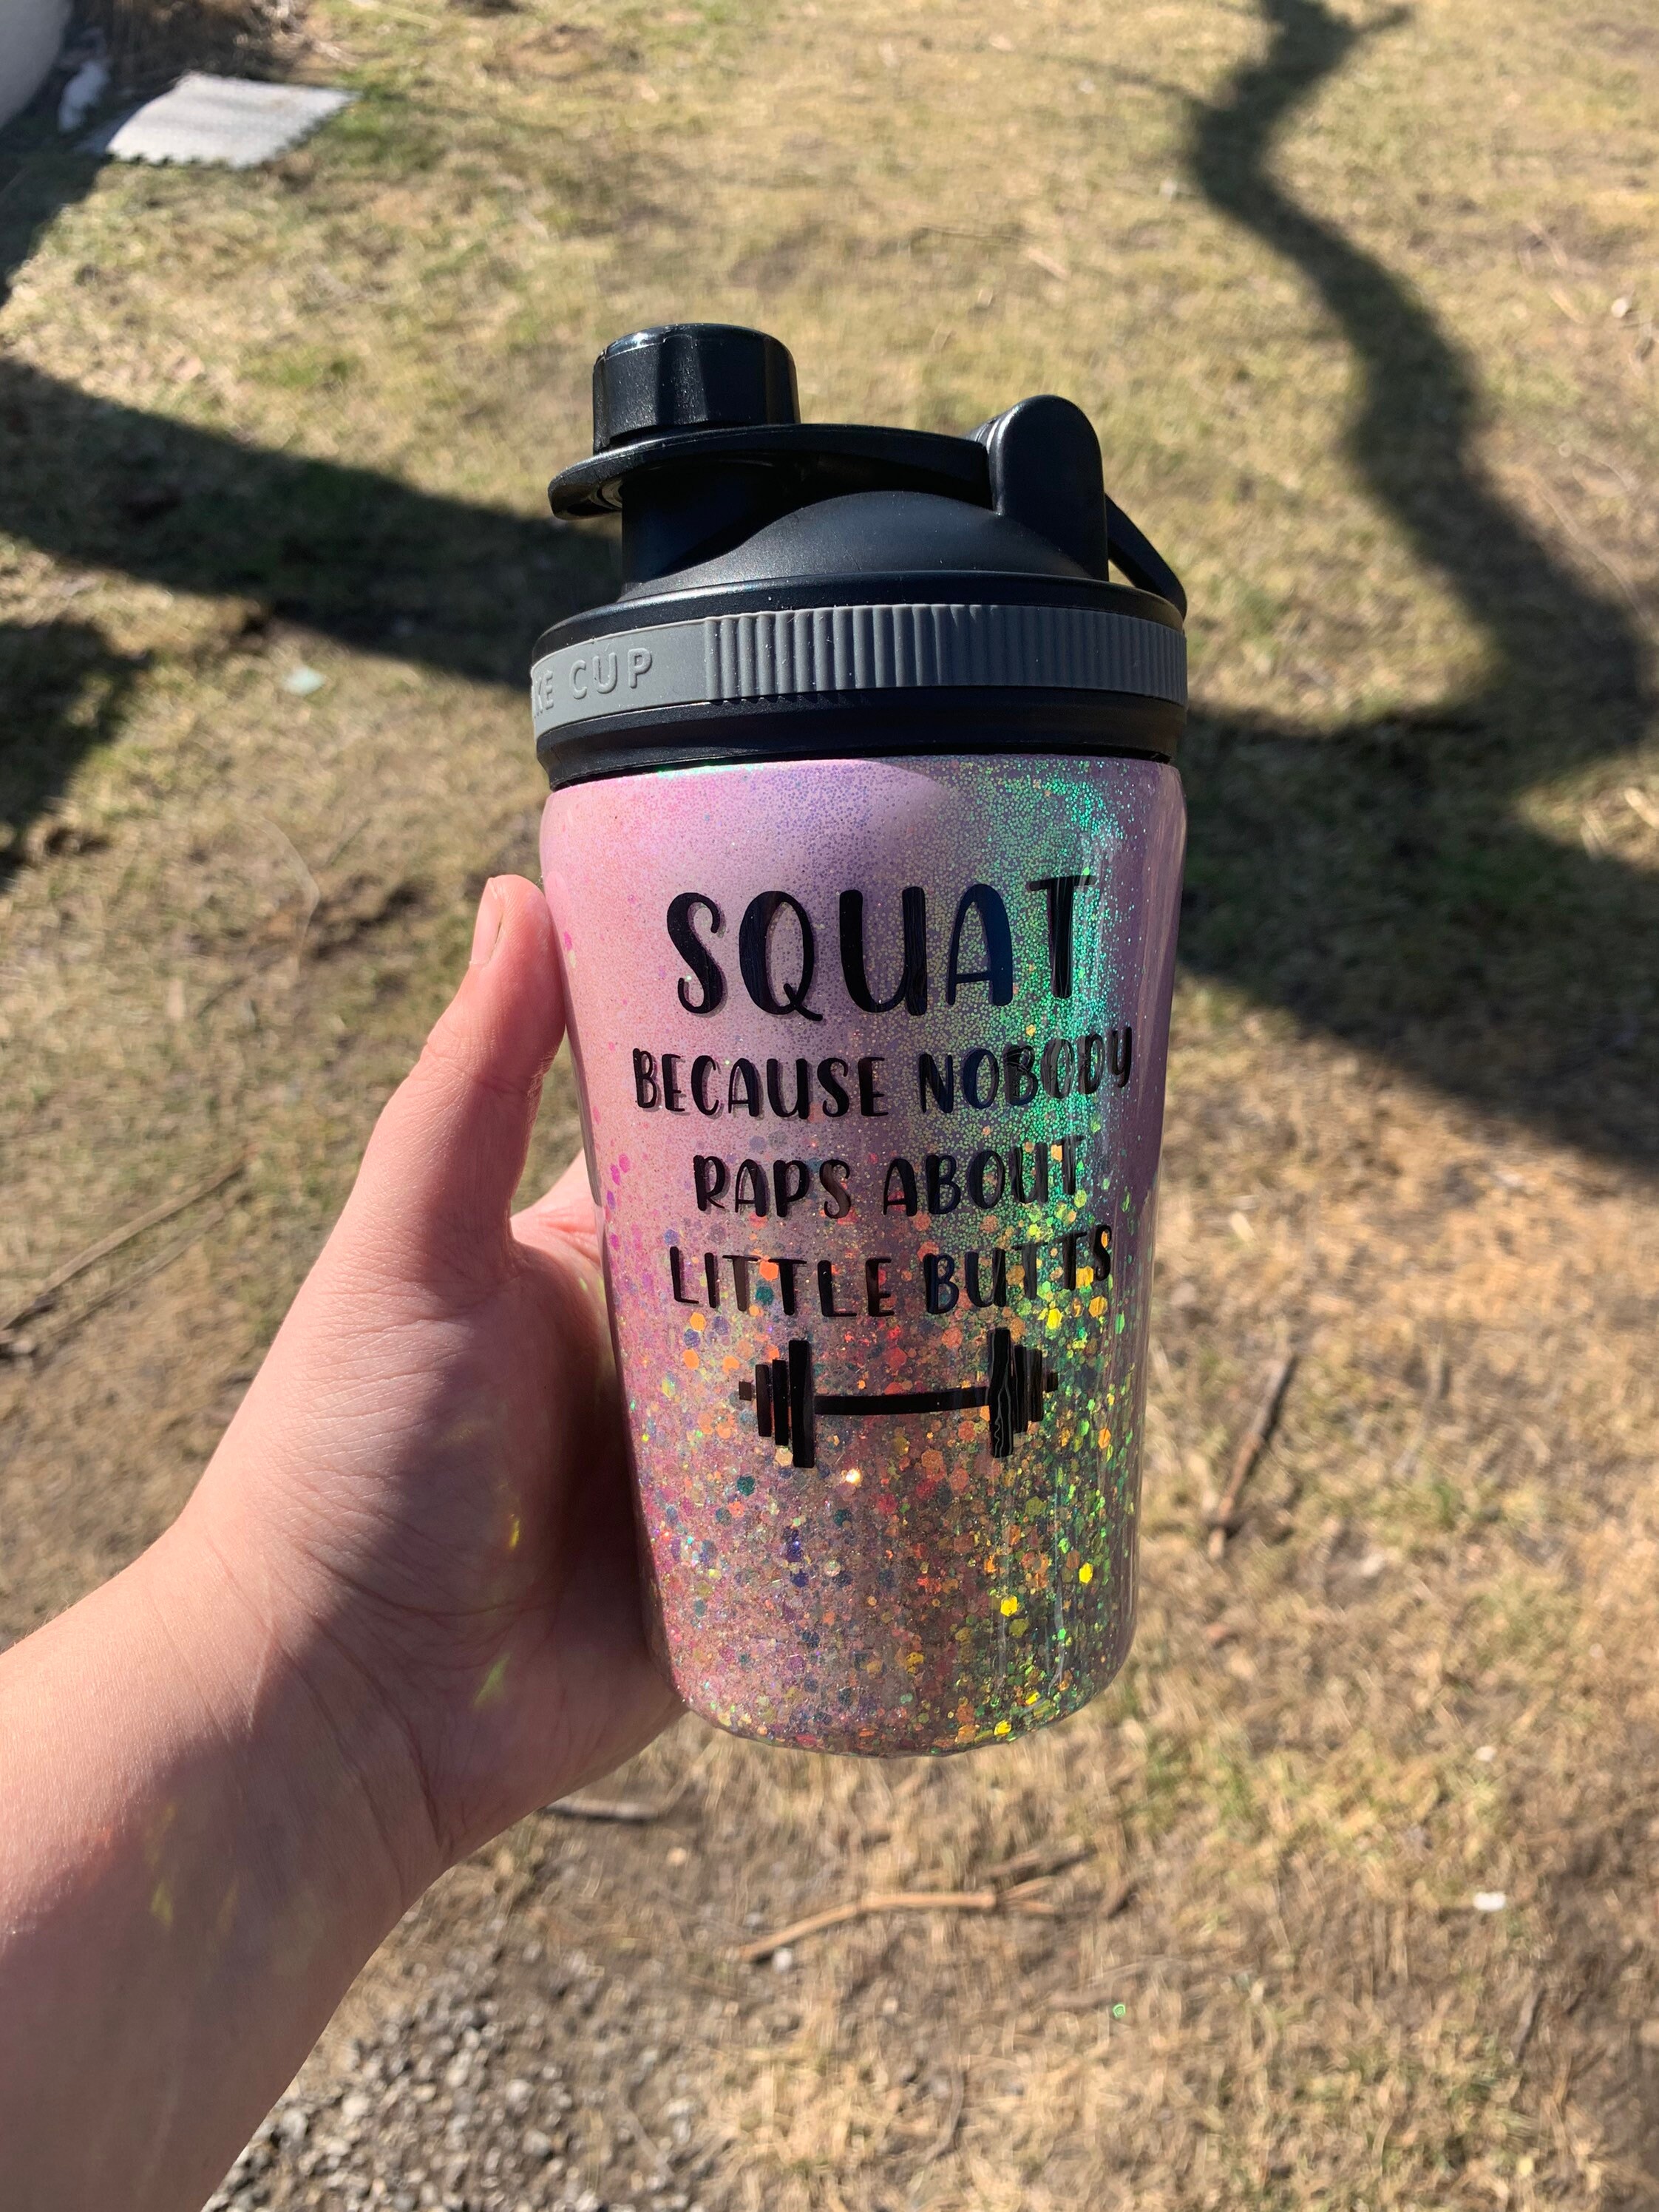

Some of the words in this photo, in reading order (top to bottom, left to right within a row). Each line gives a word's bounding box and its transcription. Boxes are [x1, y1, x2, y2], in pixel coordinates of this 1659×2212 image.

[569, 648, 652, 699] CUP
[666, 875, 1093, 1021] SQUAT
[632, 1048, 889, 1119] BECAUSE
[917, 1027, 1133, 1113] NOBODY
[692, 1155, 852, 1219] RAPS
[883, 1135, 1085, 1217] ABOUT
[669, 1246, 895, 1318] LITTLE
[923, 1224, 1112, 1314] BUTTS
